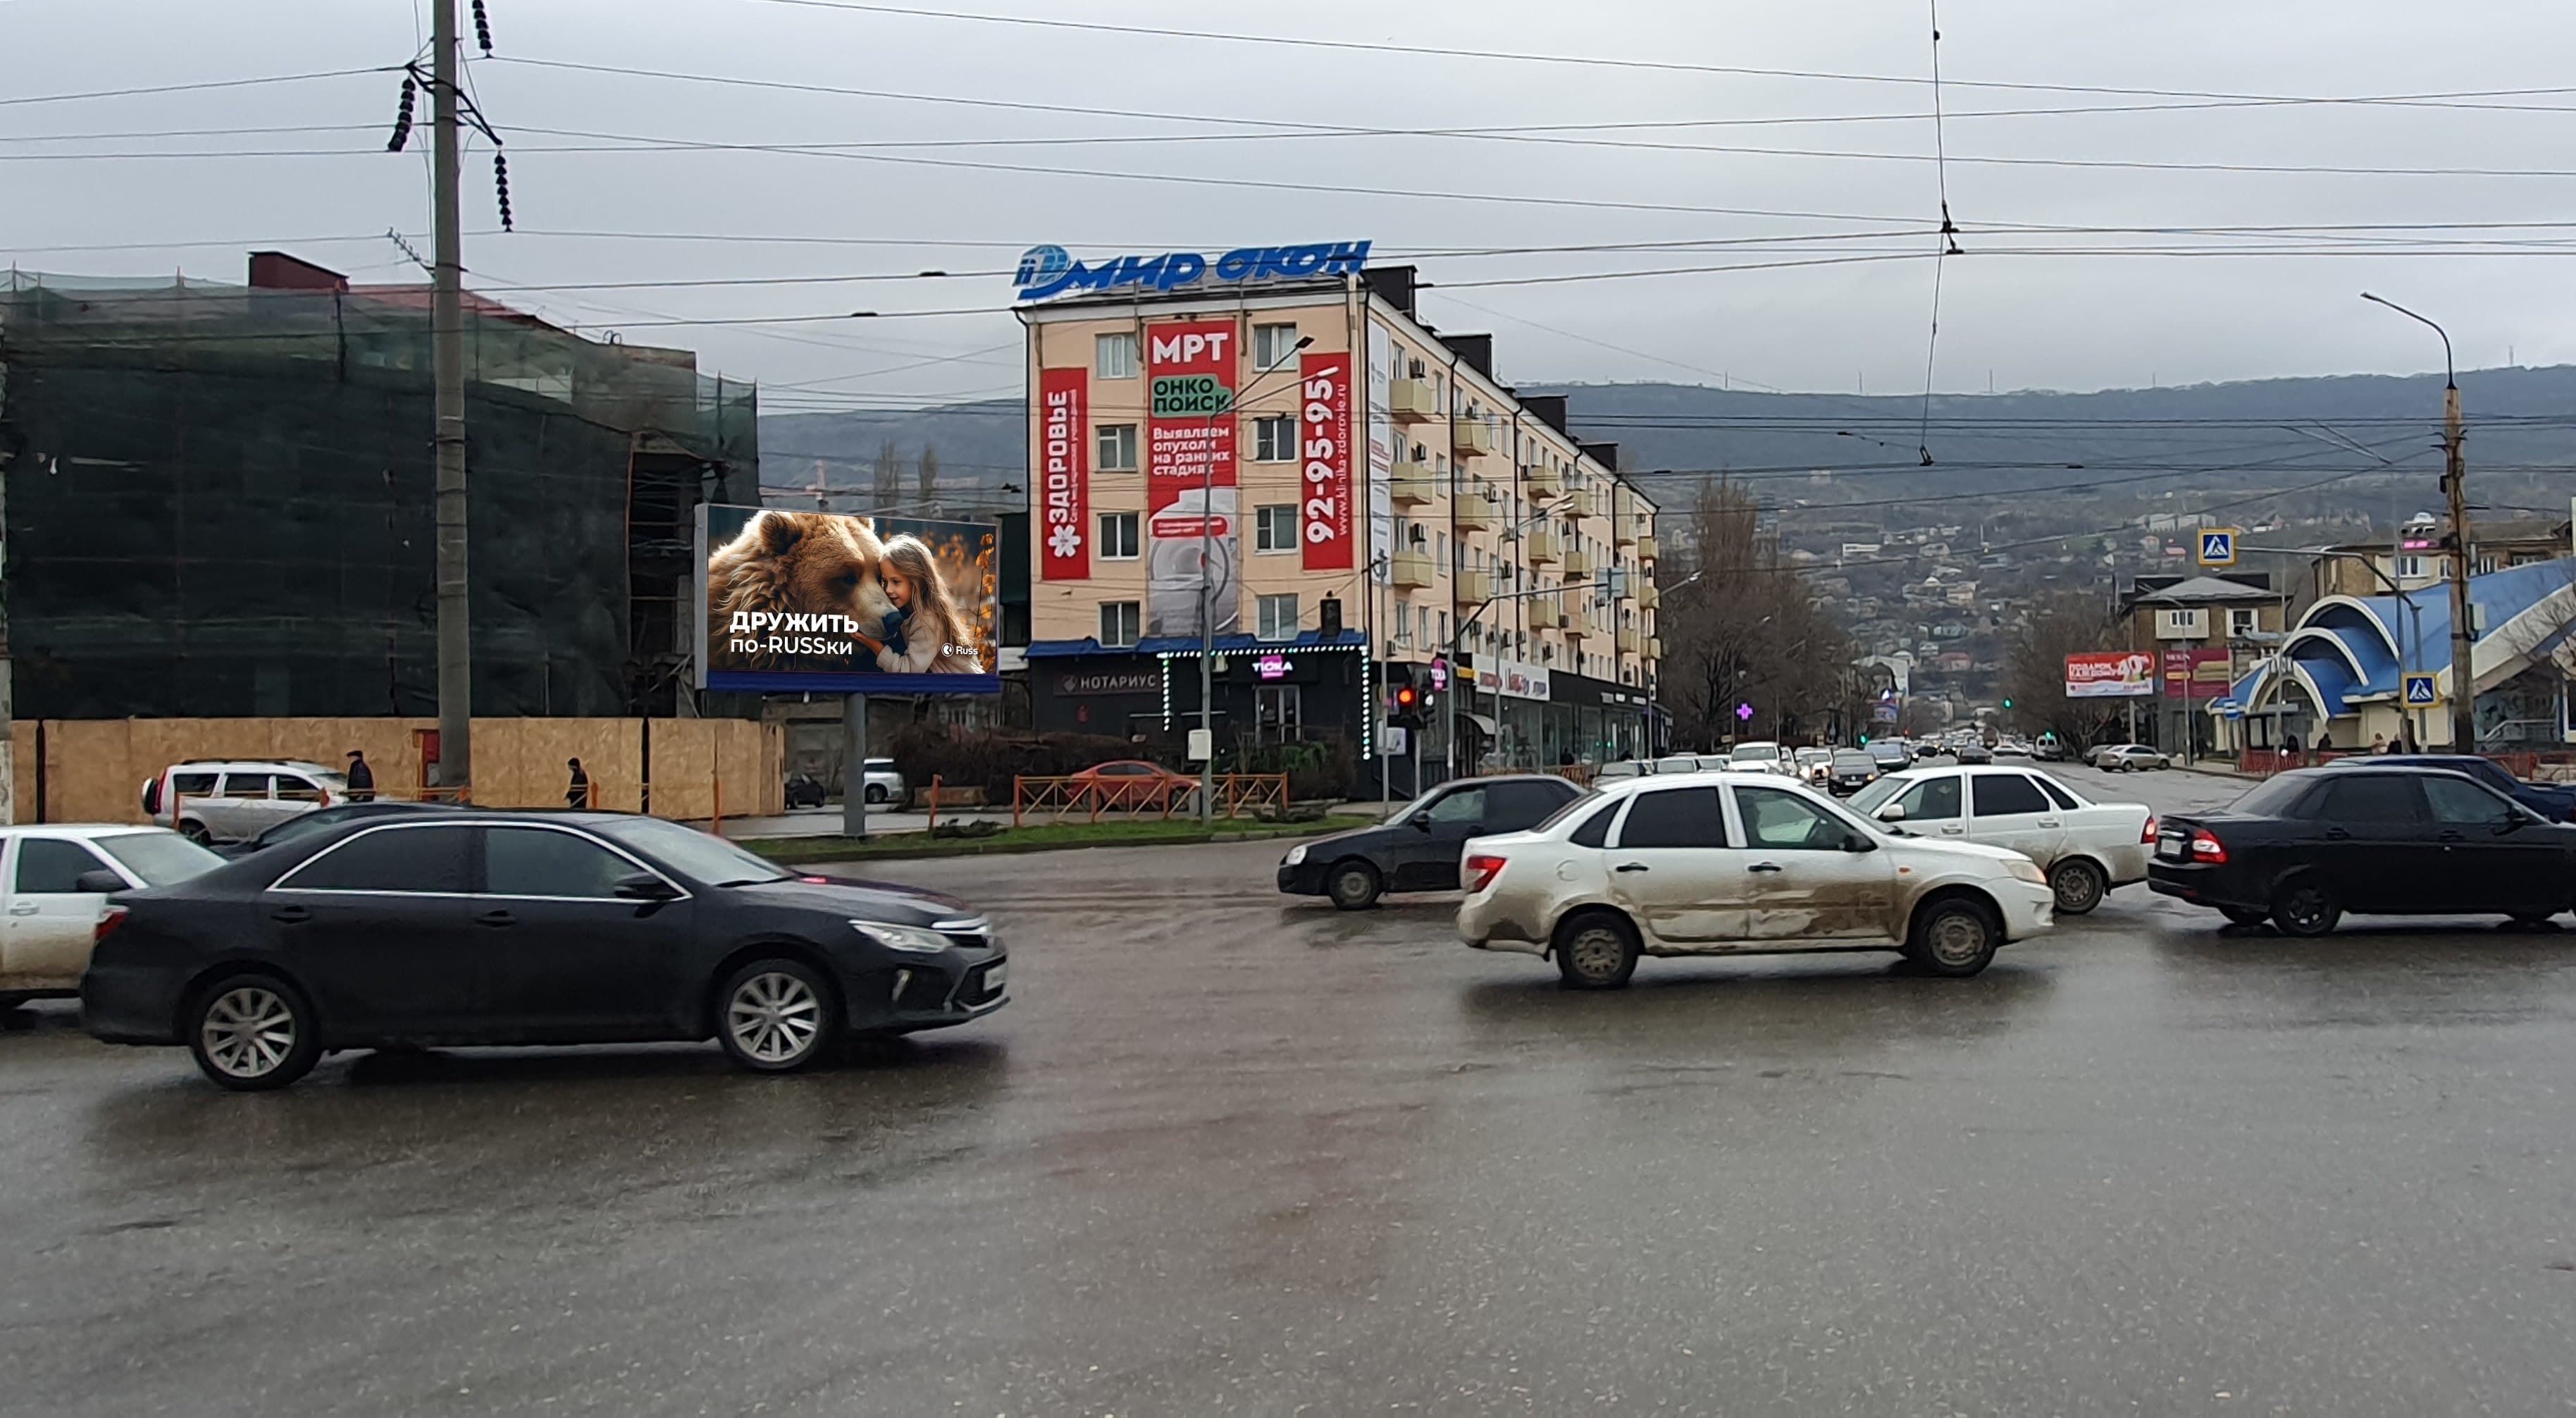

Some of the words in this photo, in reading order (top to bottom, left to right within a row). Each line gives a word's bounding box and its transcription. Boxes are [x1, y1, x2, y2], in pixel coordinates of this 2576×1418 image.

[1153, 333, 1228, 364] МРТ
[1153, 378, 1214, 396] ОНКО
[1153, 394, 1228, 412] ПОИСК
[1153, 427, 1229, 440] Выявляем
[1048, 391, 1070, 524] ЗДОРОВЬЕ
[1153, 453, 1171, 464] на
[1305, 379, 1335, 543] 92-95-95
[729, 611, 860, 634] ДРУЖИТЬ
[955, 646, 979, 655] Russ
[1080, 674, 1156, 689] НОТАРИУС
